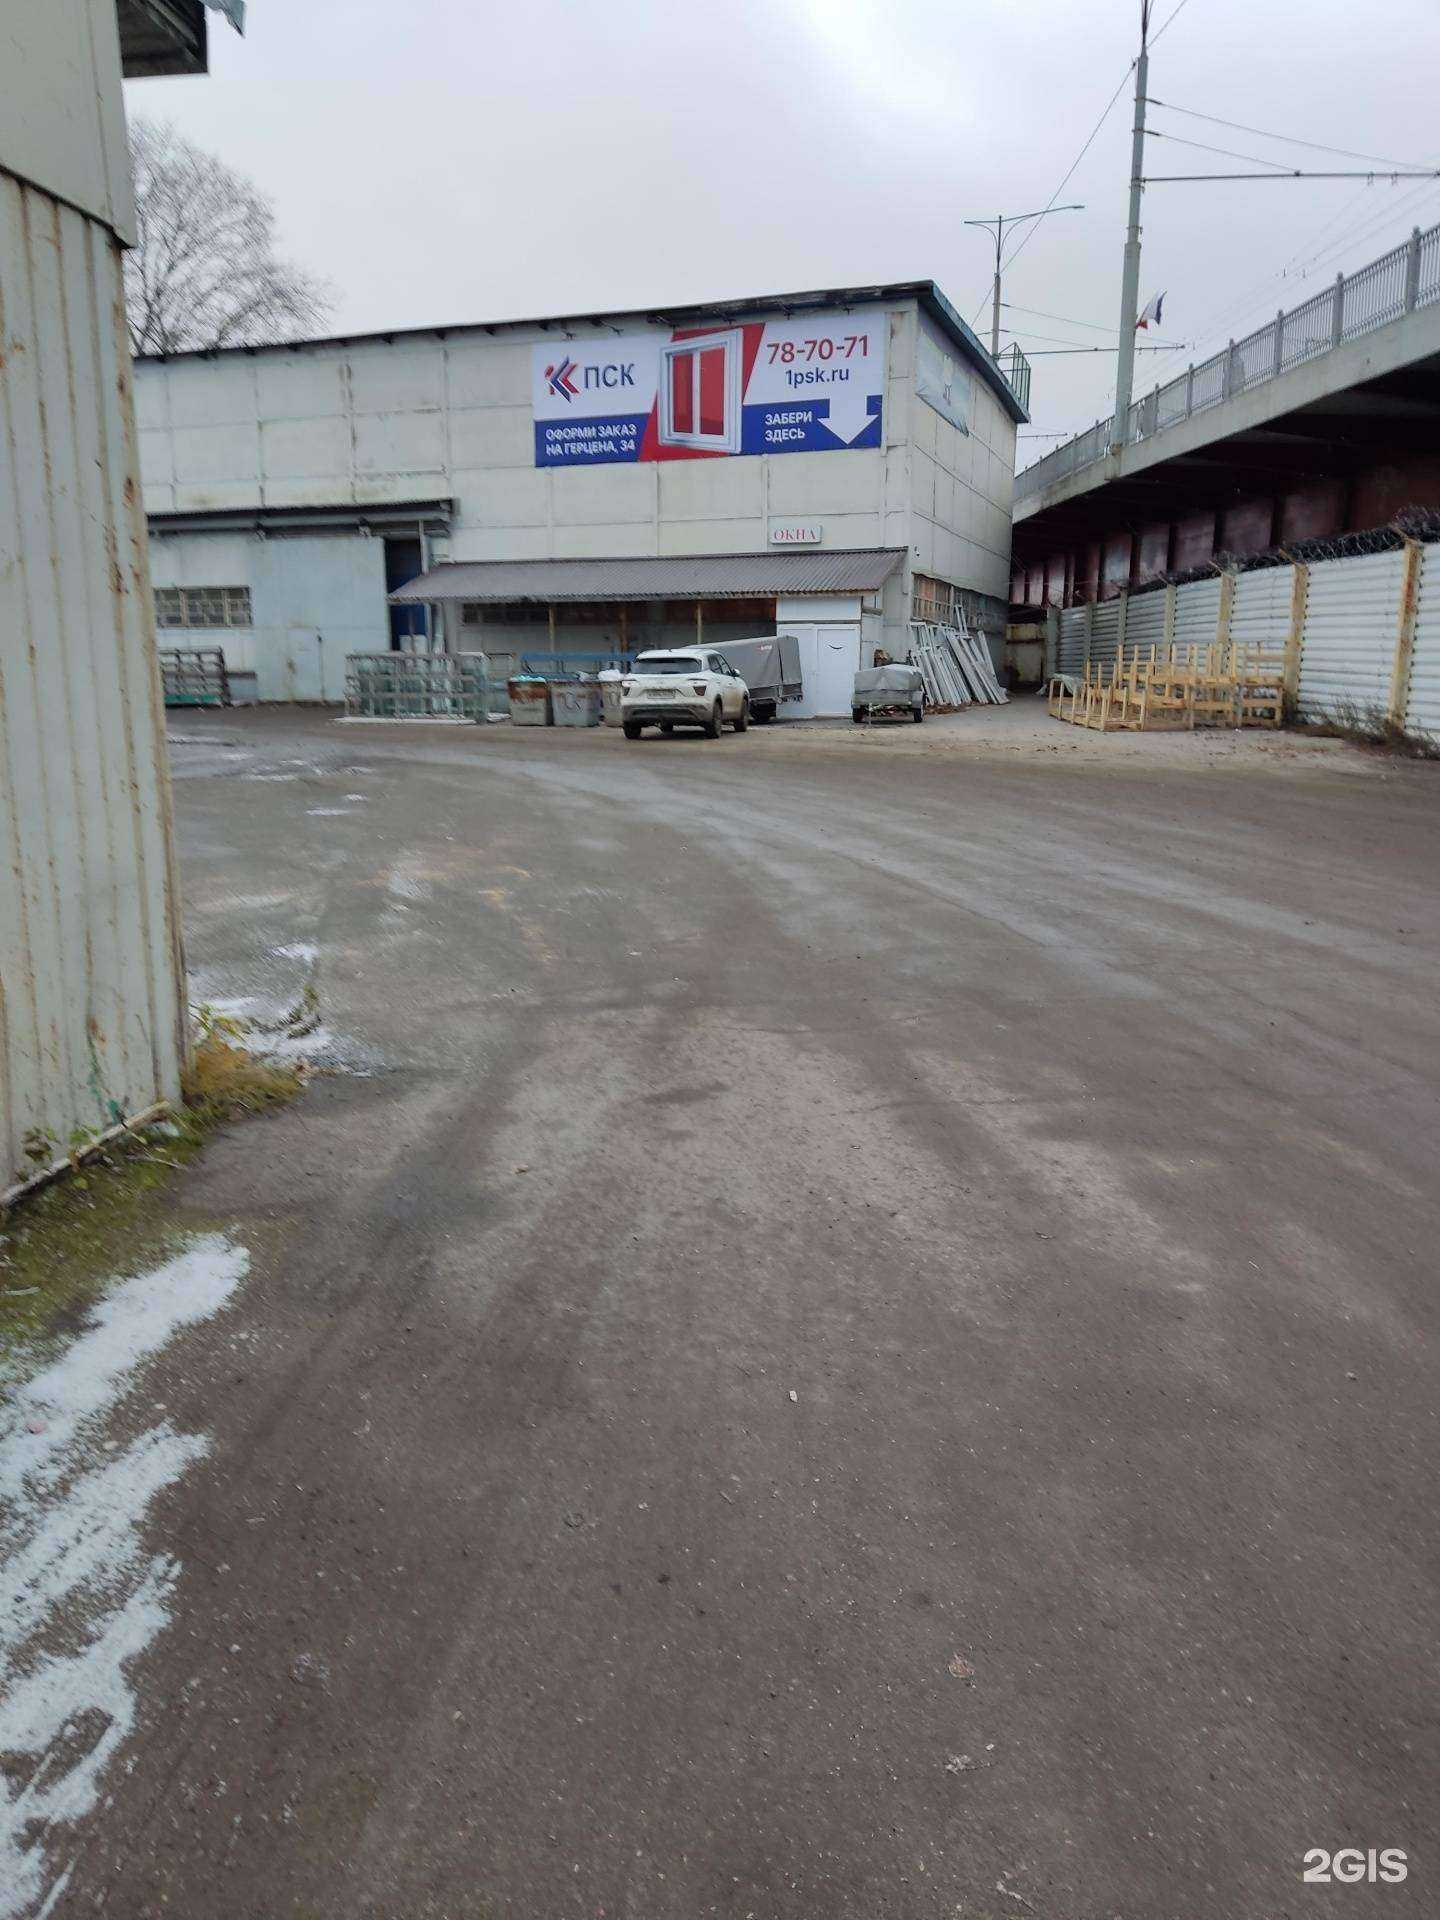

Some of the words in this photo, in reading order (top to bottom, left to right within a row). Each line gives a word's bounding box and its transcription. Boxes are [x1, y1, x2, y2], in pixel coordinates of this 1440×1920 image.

[766, 334, 869, 365] 78-70-71
[583, 363, 635, 390] ПСК
[785, 366, 850, 390] 1psk.ru
[764, 410, 813, 426] ЗАБЕРИ
[545, 426, 597, 441] ОФОРМИ
[597, 423, 637, 438] ЗАКАЗ
[764, 427, 806, 443] ЗДЕСЬ
[545, 443, 563, 456] НА
[564, 440, 619, 455] ГЕРЦЕНА,
[620, 438, 635, 452] 34
[773, 528, 817, 541] ОКНА
